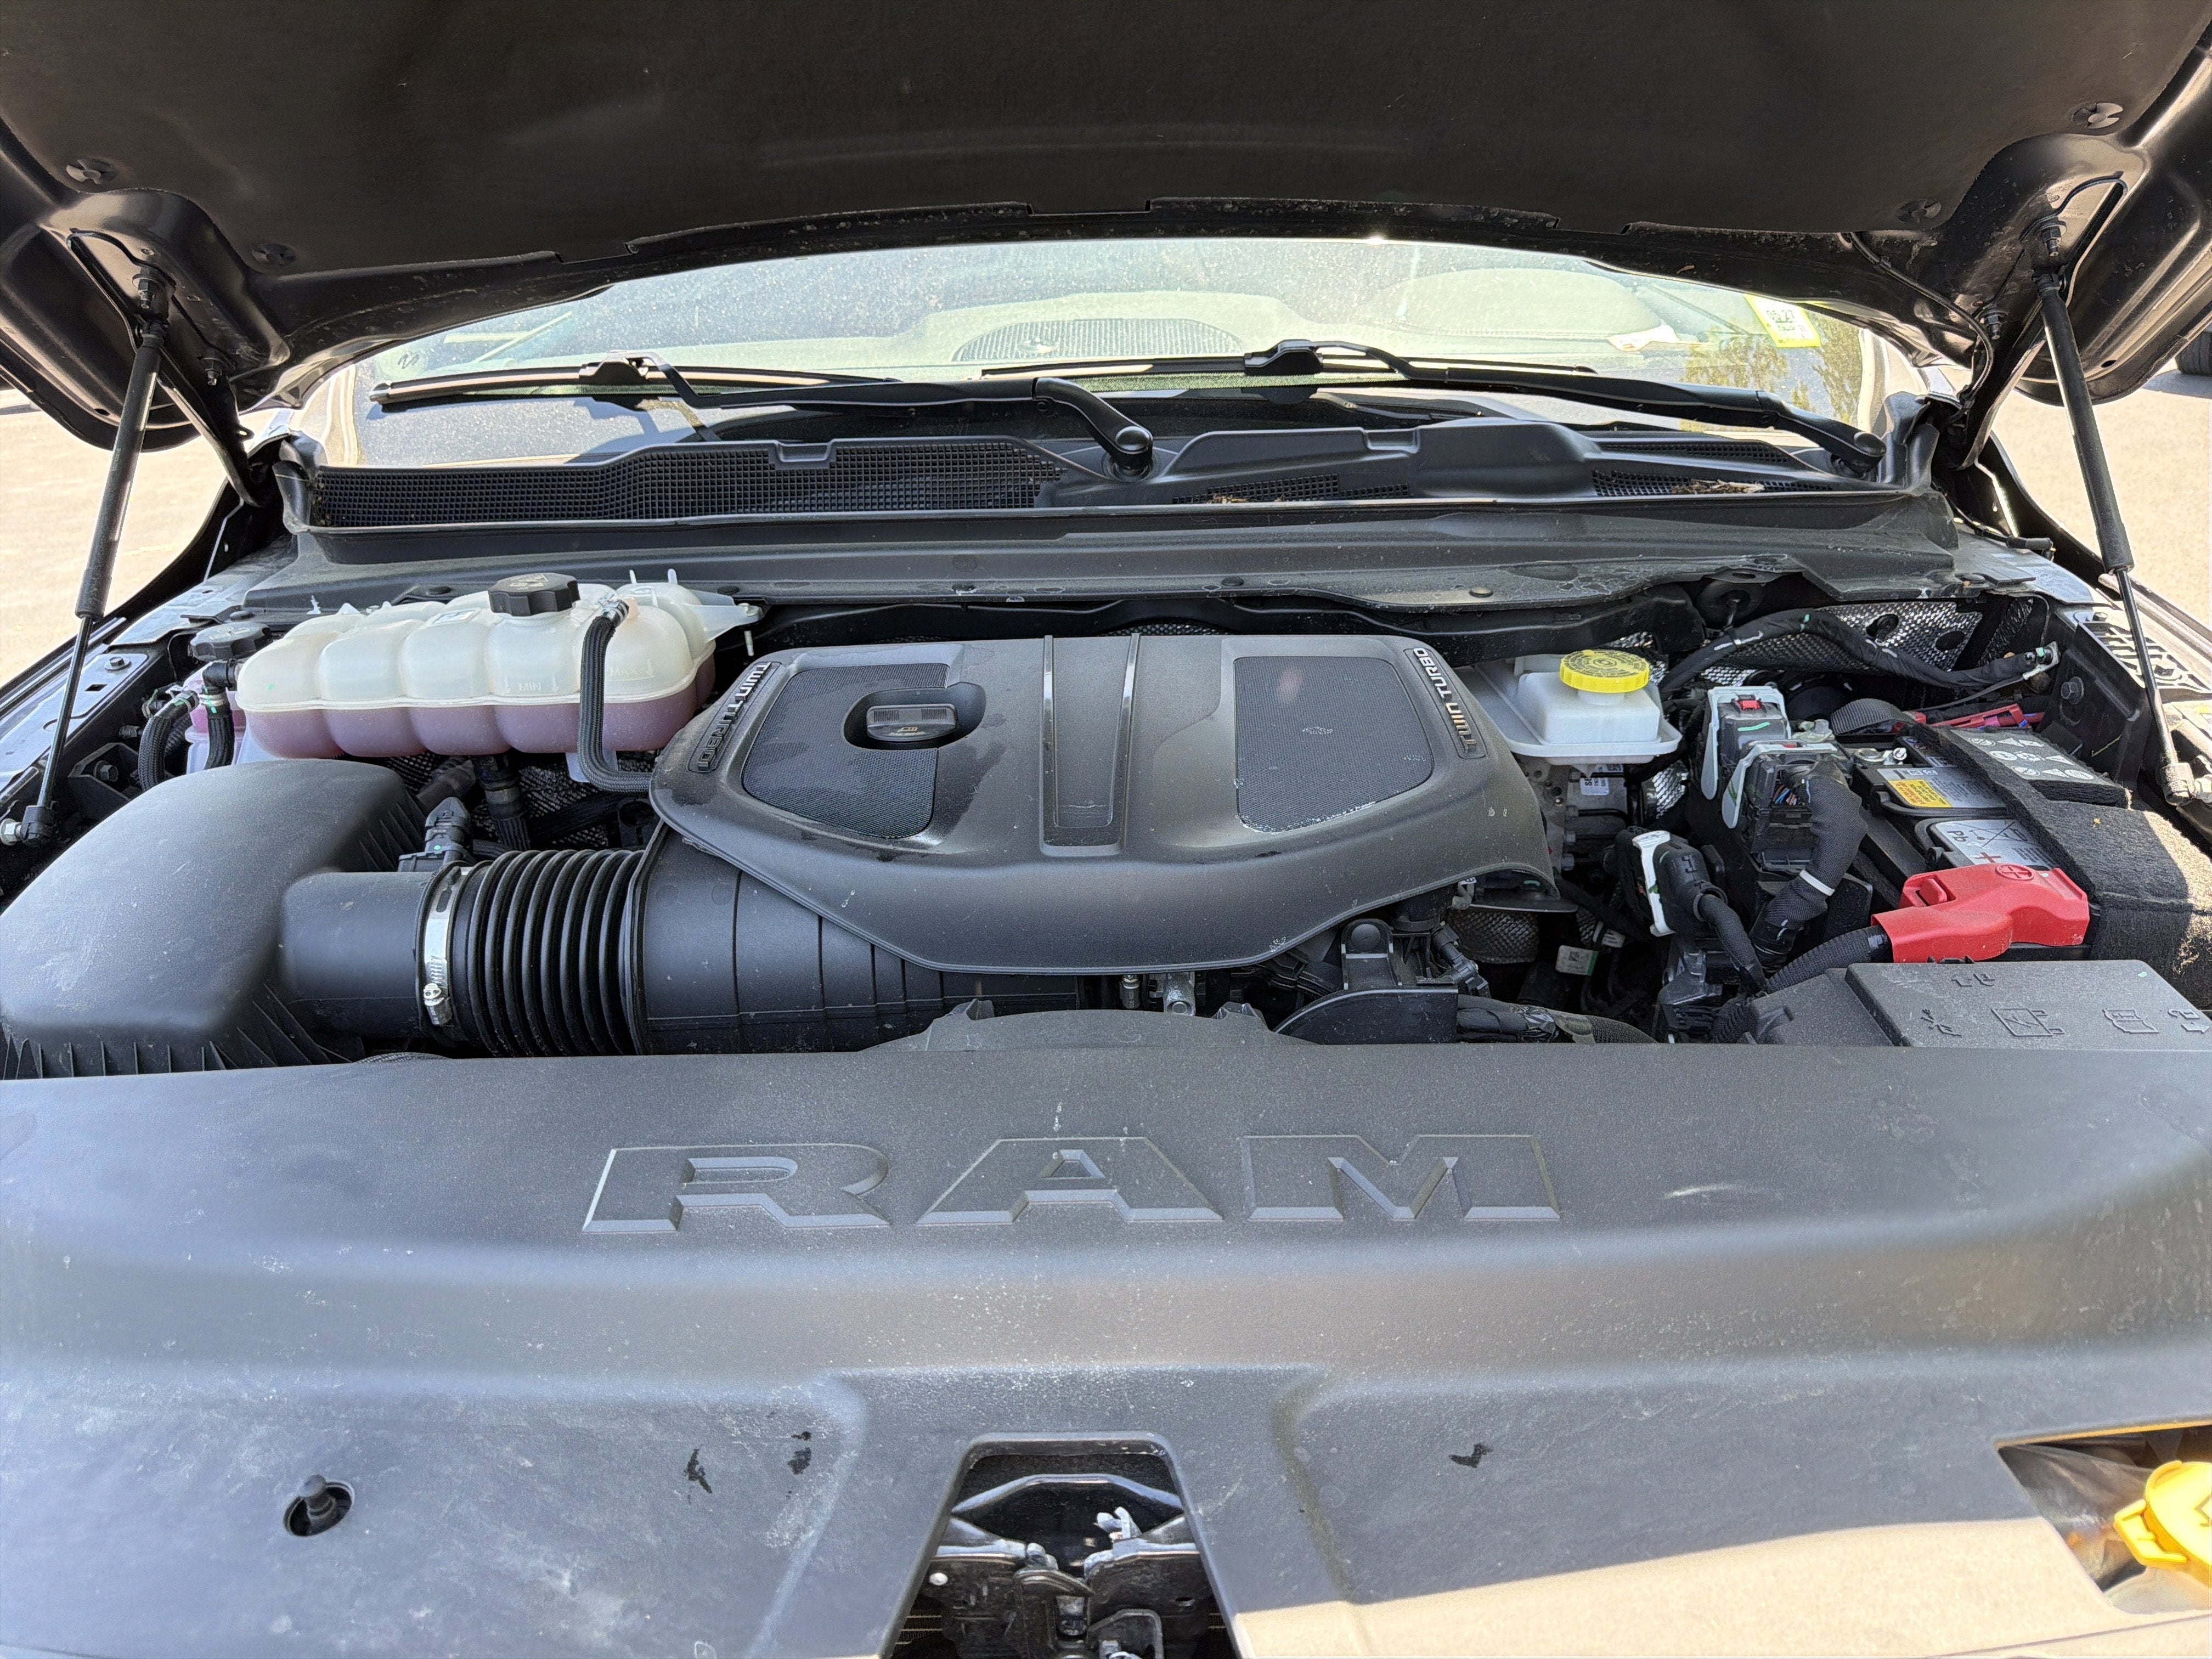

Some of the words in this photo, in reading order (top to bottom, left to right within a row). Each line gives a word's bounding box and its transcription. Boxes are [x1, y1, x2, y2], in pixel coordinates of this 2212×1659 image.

[519, 681, 542, 691] MIN
[610, 665, 638, 676] MAX
[735, 662, 772, 702] TWIN
[1412, 647, 1453, 700] TURBO
[697, 701, 743, 769] TURBO
[1446, 702, 1477, 753] TWIN
[1946, 830, 1969, 842] Pb
[582, 1133, 1561, 1233] RAM
